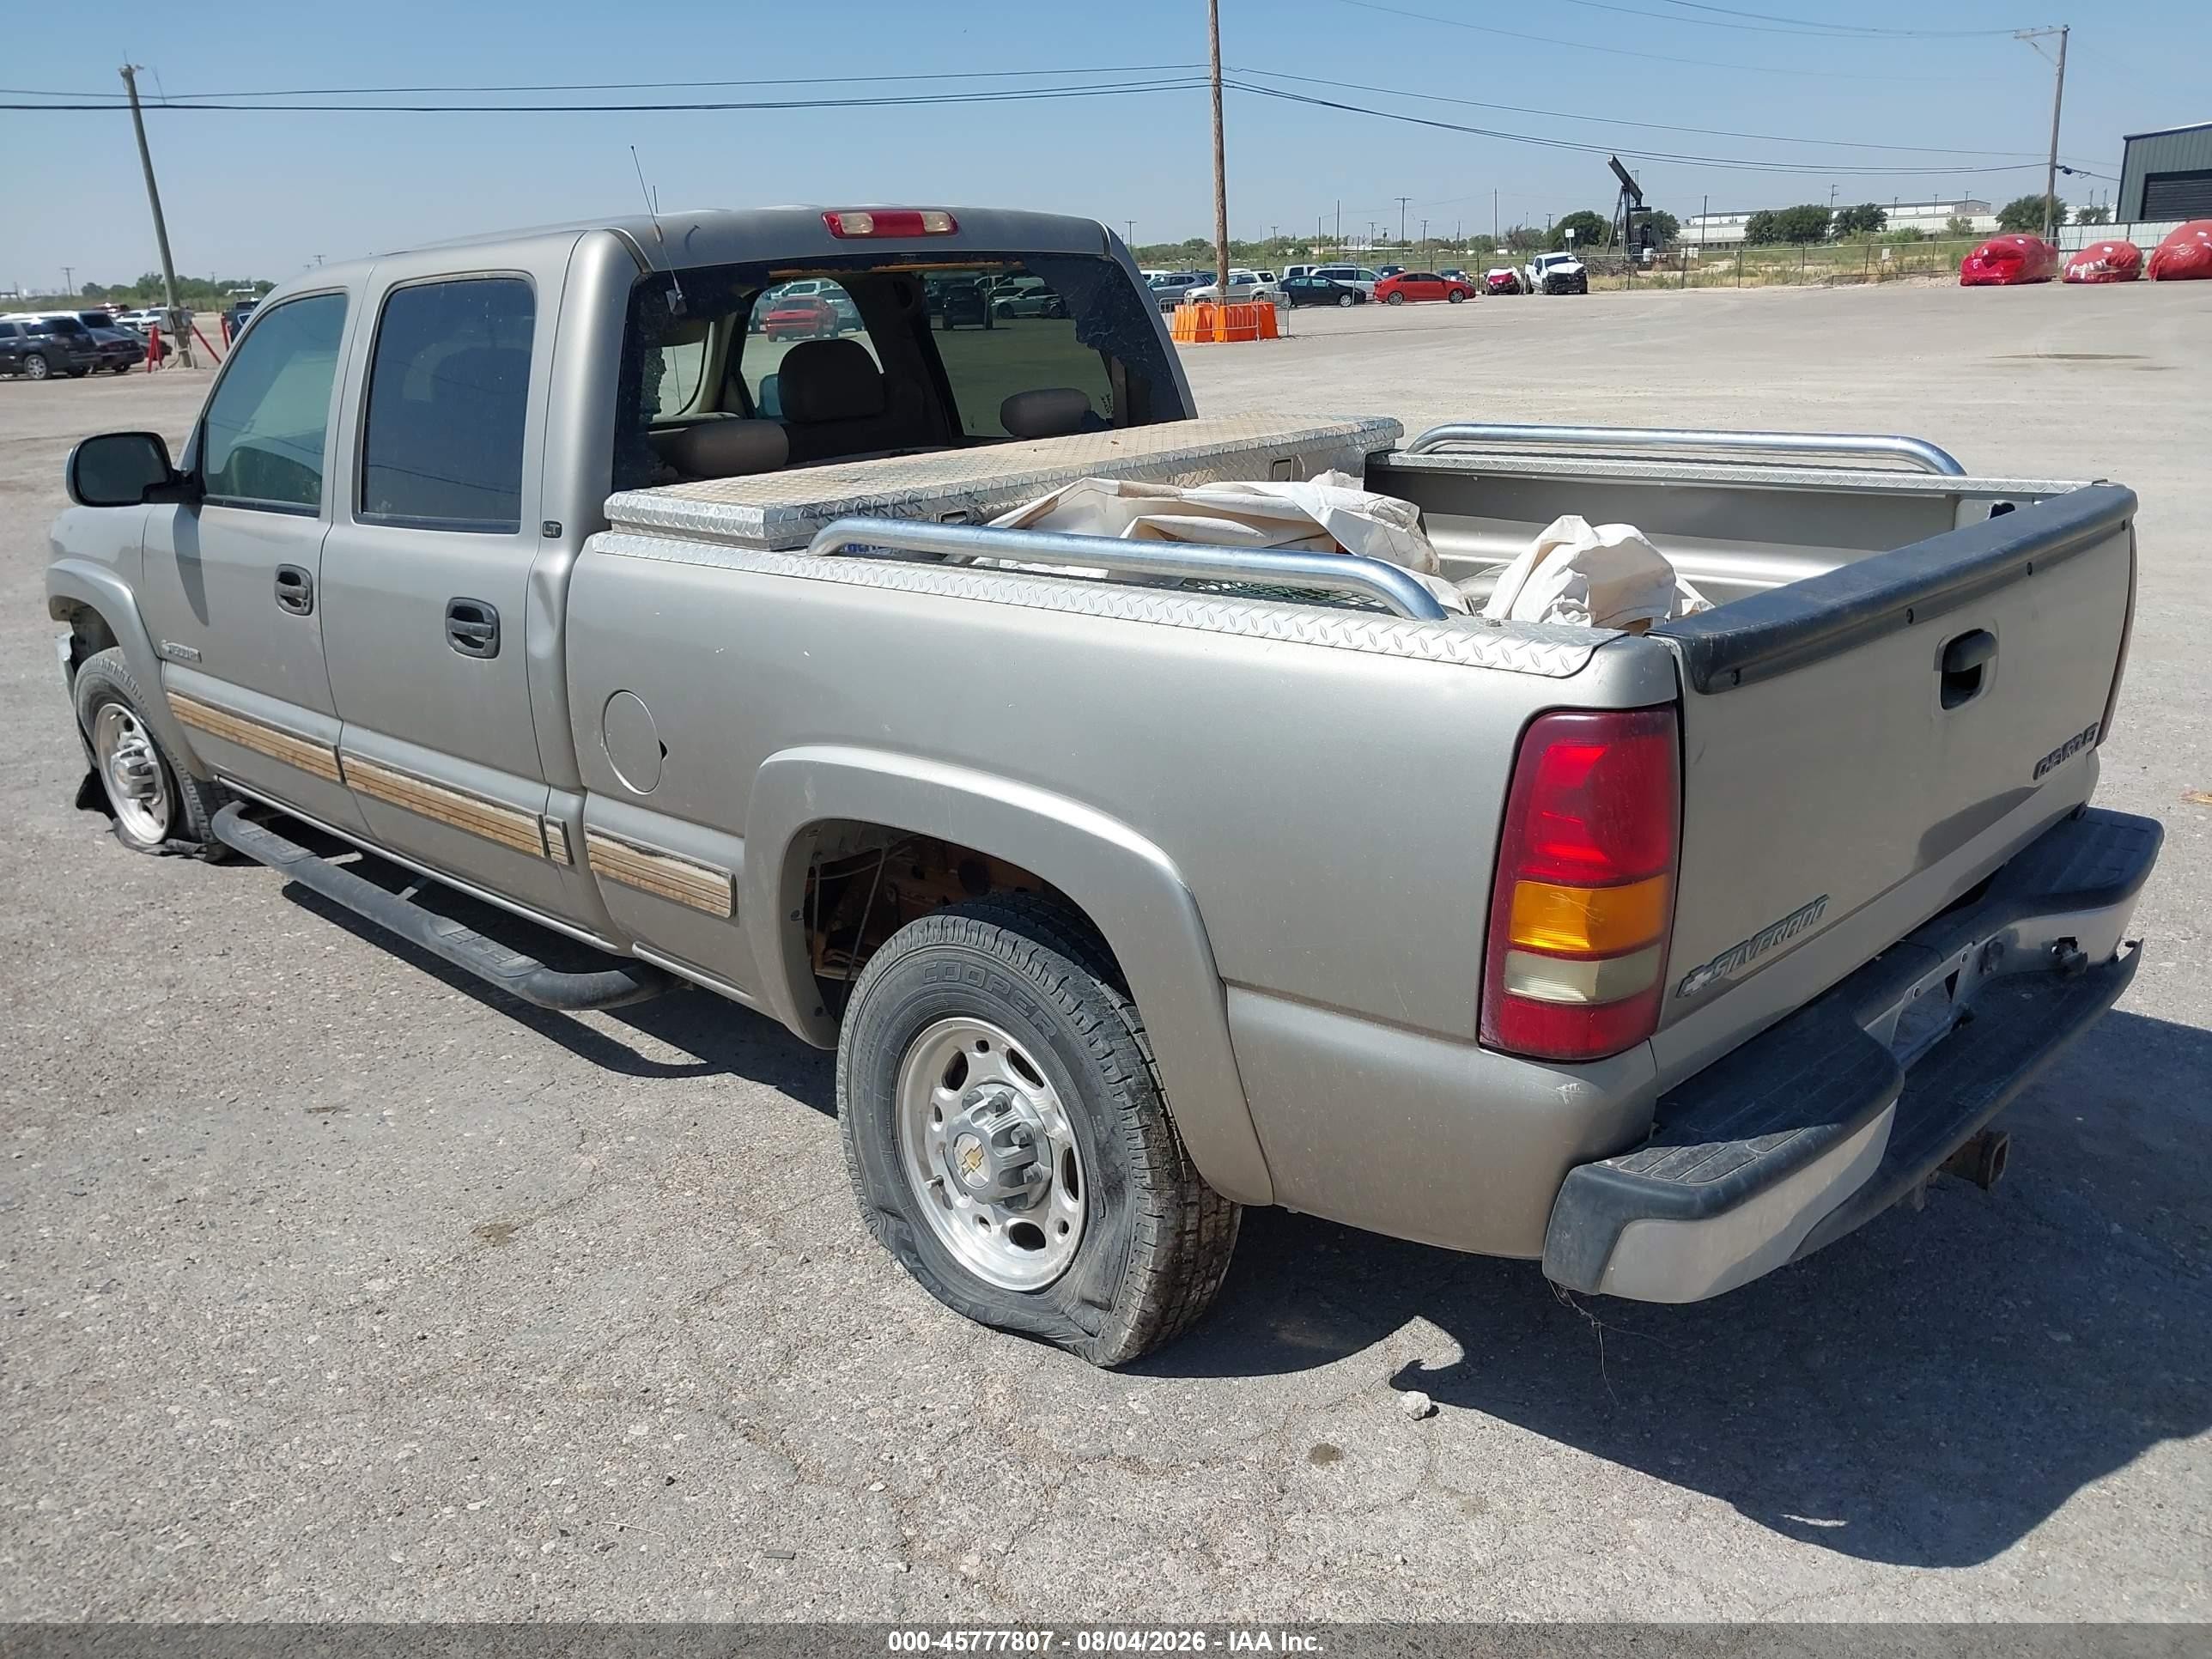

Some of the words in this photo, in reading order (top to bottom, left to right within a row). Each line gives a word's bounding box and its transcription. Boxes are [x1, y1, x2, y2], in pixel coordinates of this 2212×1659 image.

[543, 523, 561, 535] LT
[1709, 893, 1831, 983] SILVERADO
[921, 960, 1060, 1042] COOPER
